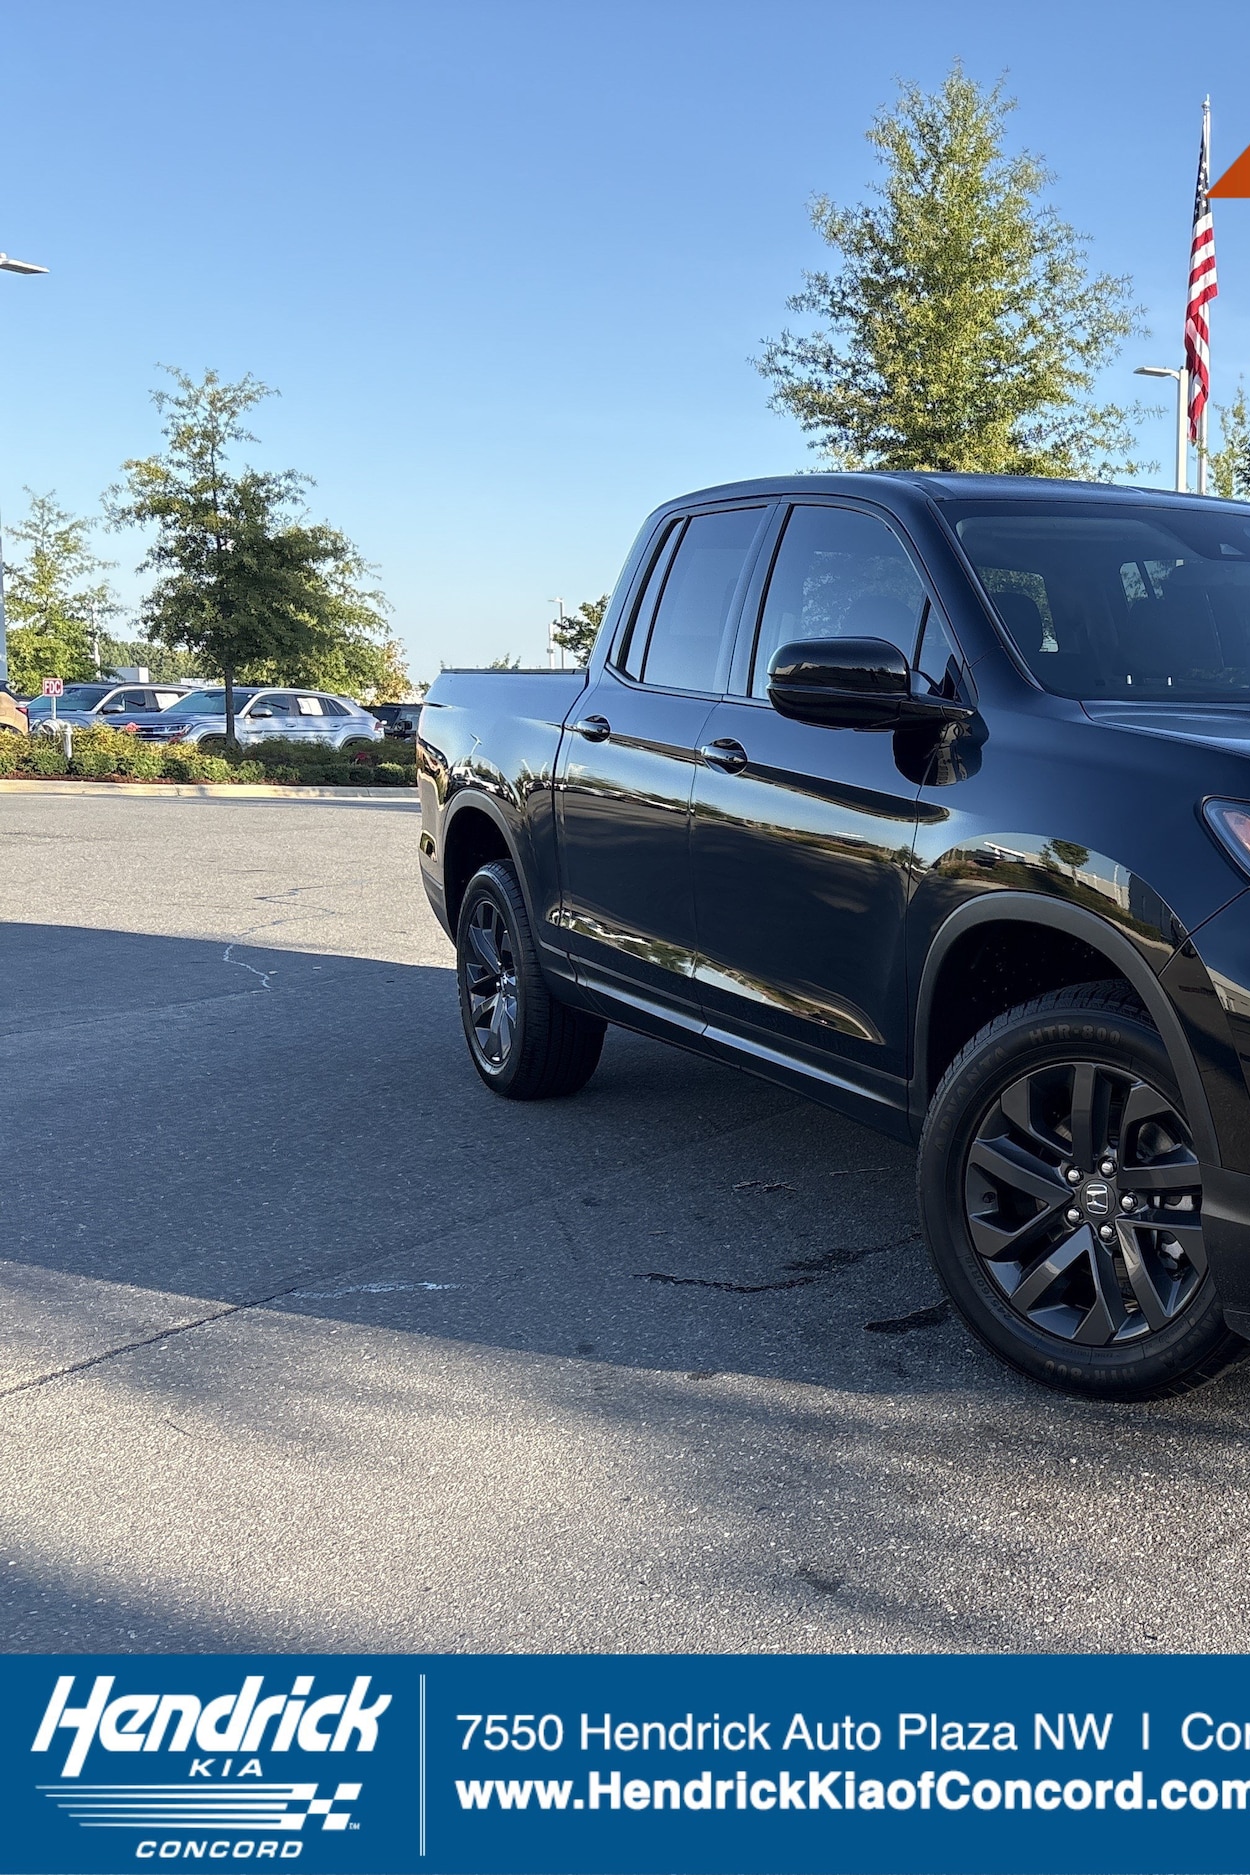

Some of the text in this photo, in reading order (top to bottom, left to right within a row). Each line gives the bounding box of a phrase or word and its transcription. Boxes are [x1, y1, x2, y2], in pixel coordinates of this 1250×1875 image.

[45, 681, 60, 694] FDC
[933, 1023, 1122, 1153] ADVANTA HTR-800
